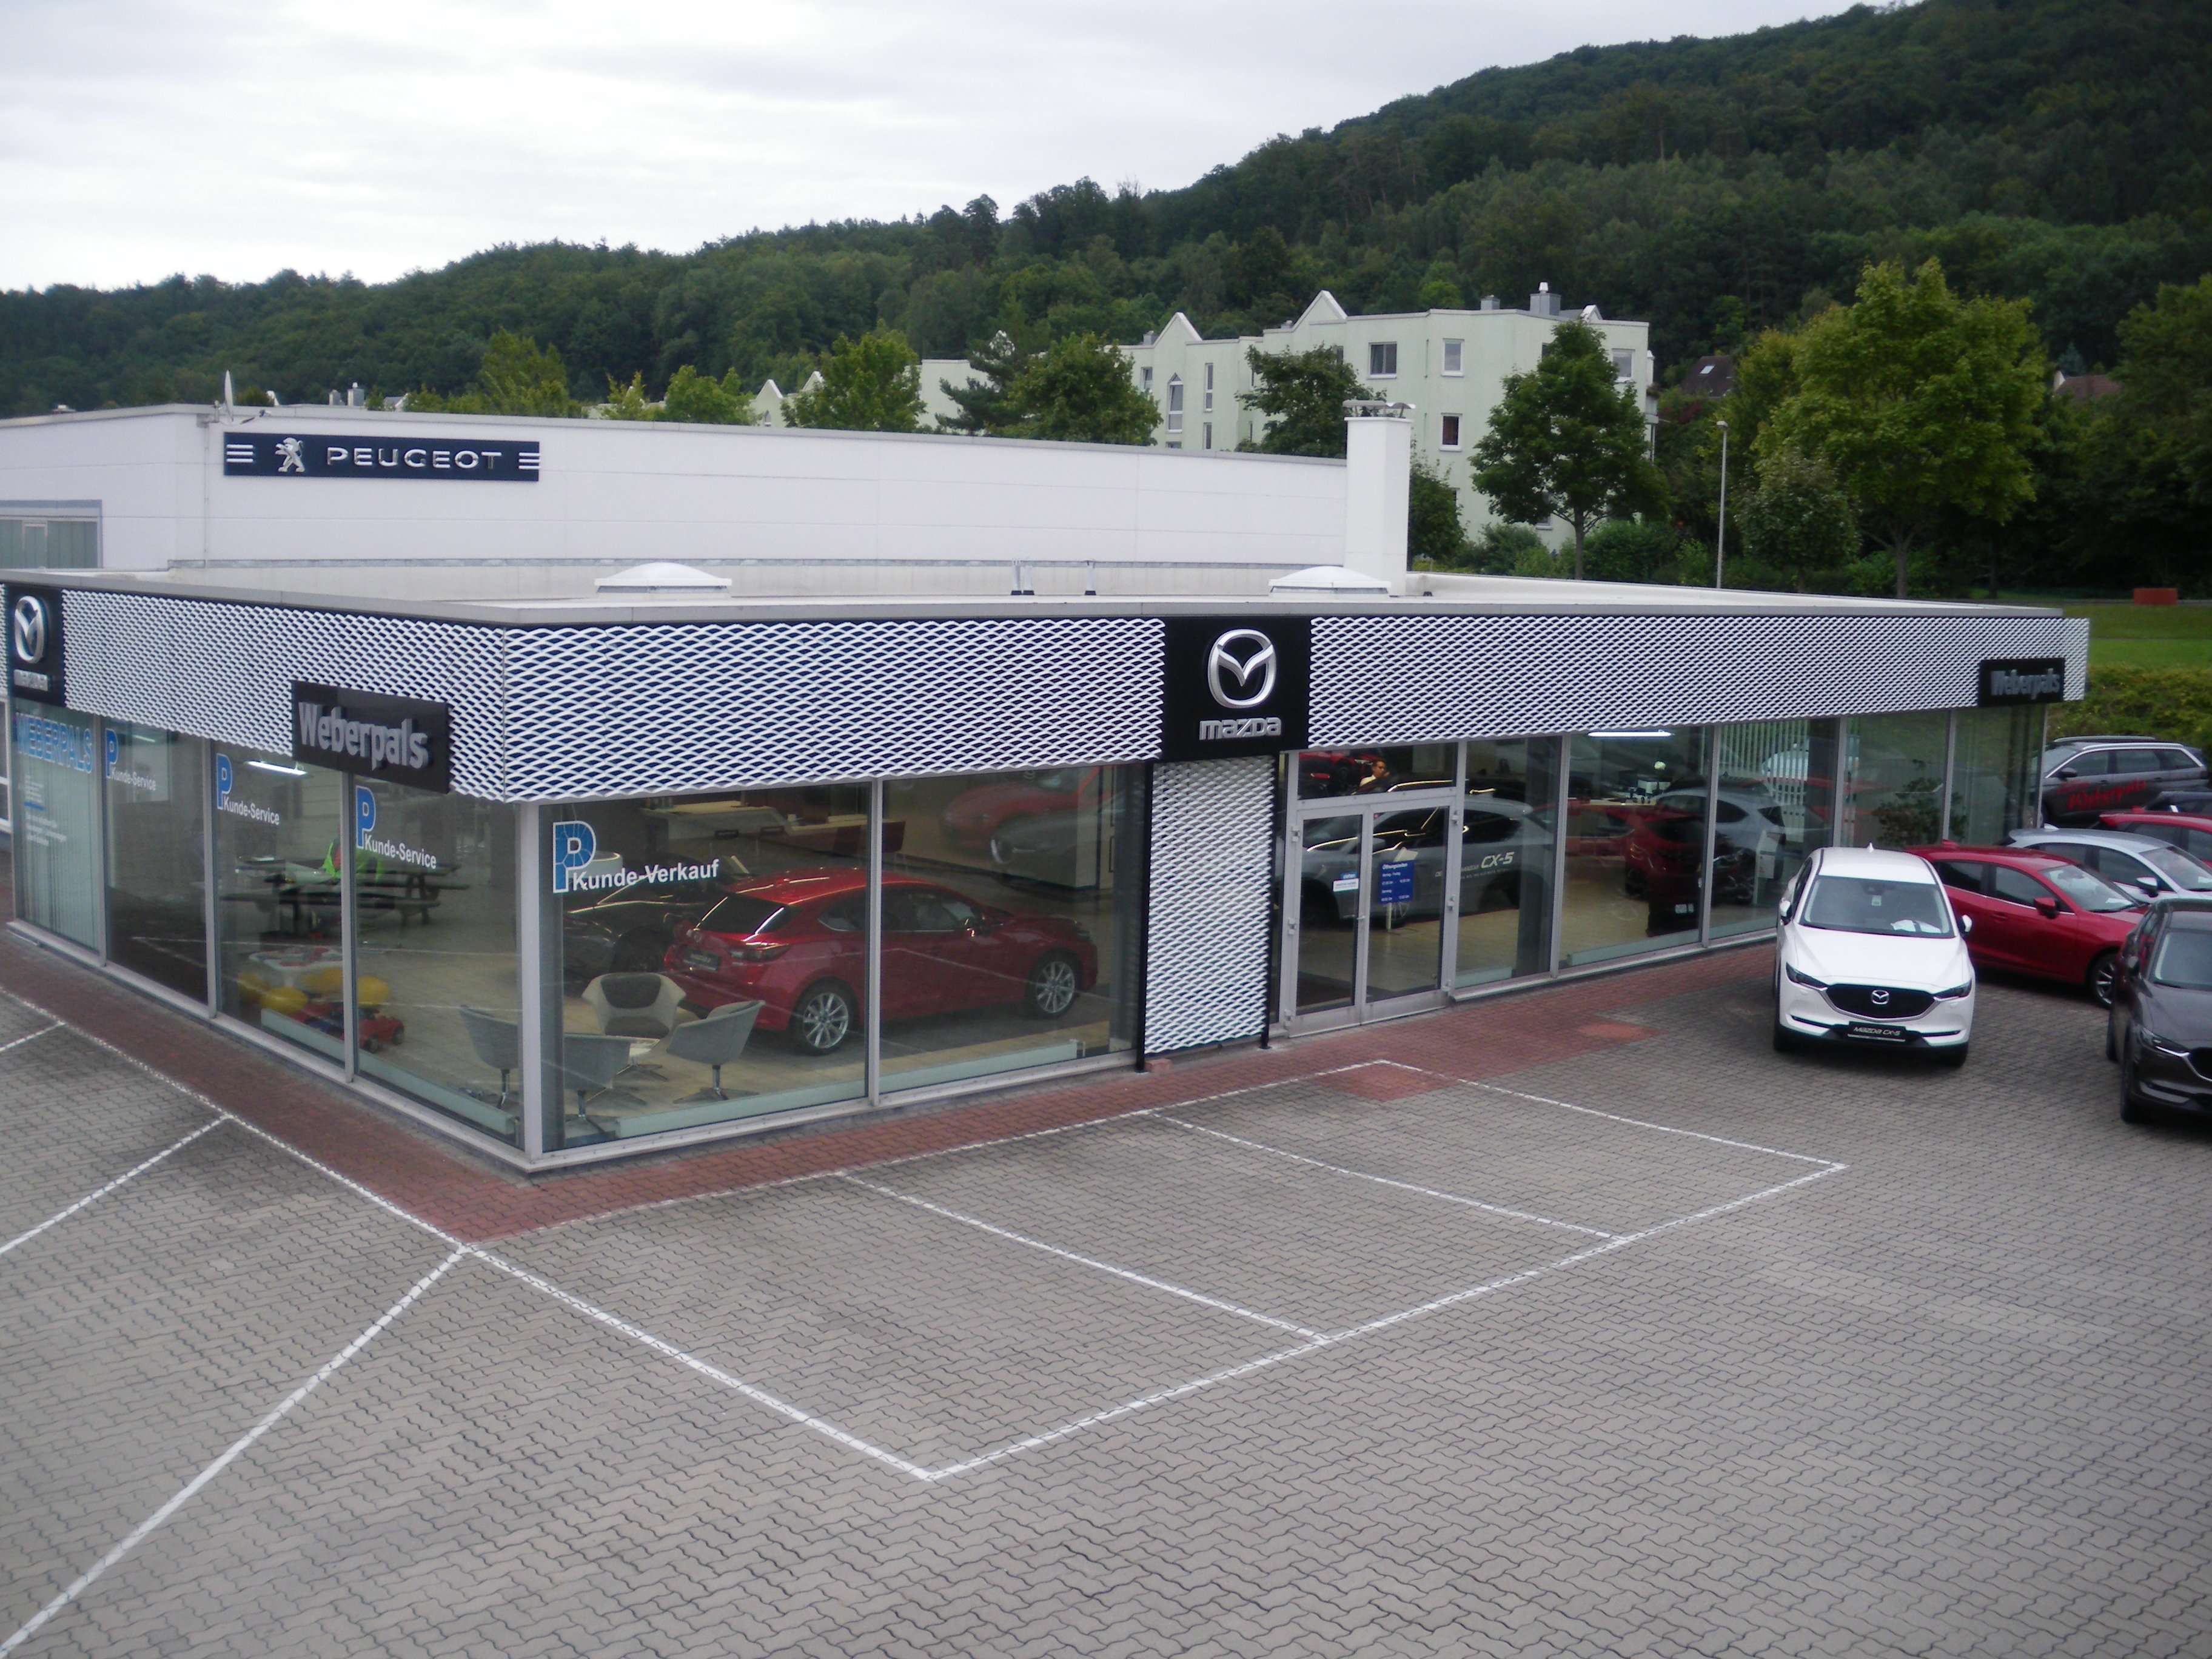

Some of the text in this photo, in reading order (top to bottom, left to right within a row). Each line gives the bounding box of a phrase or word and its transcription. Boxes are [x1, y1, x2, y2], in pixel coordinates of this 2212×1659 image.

[327, 447, 502, 470] PEUGEOT
[1991, 668, 2061, 700] Weberpals
[298, 702, 429, 771] Weberpals
[1199, 717, 1282, 740] mazda
[16, 711, 92, 774] WEBERPALS
[1481, 851, 1515, 869] CX-5
